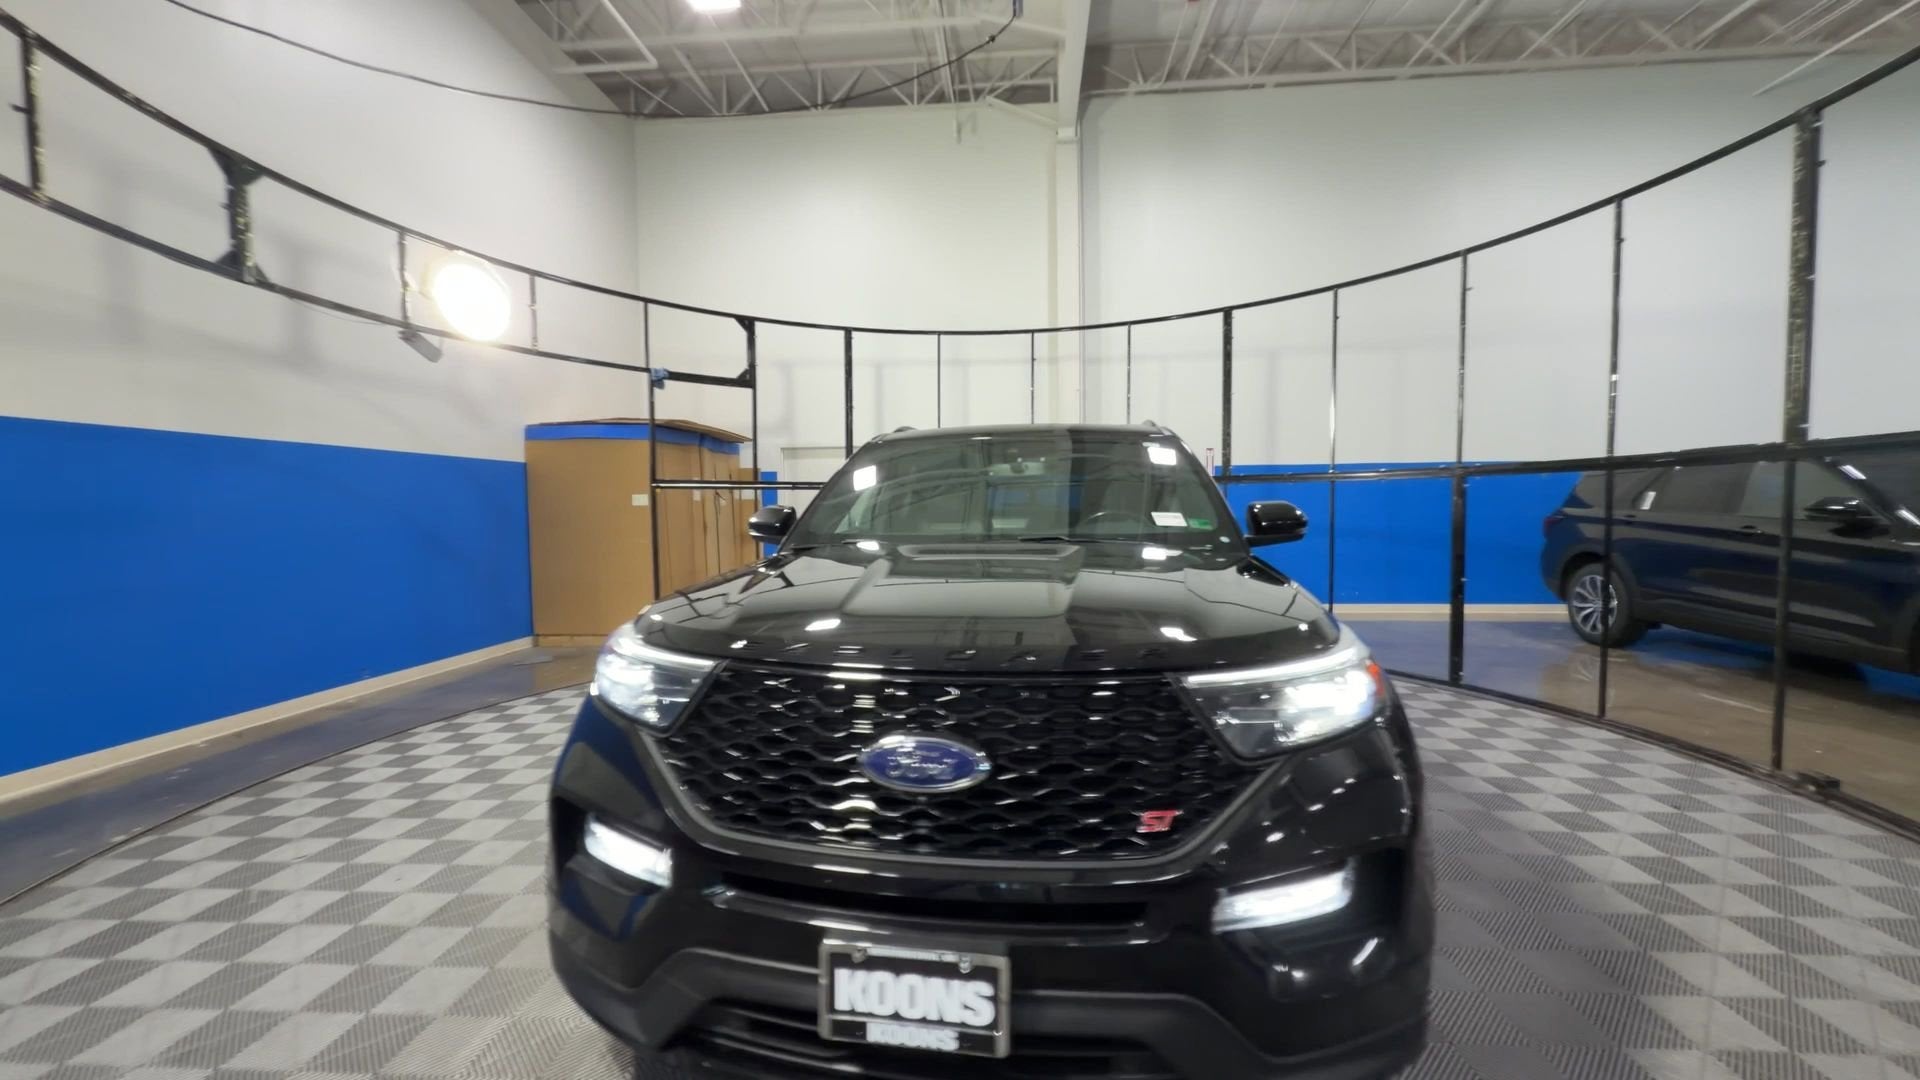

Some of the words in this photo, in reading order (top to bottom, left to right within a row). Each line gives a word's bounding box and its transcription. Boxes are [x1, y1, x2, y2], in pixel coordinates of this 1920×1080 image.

[1136, 810, 1181, 833] ST
[834, 968, 996, 1027] KOONS
[866, 1022, 960, 1051] KOONS
